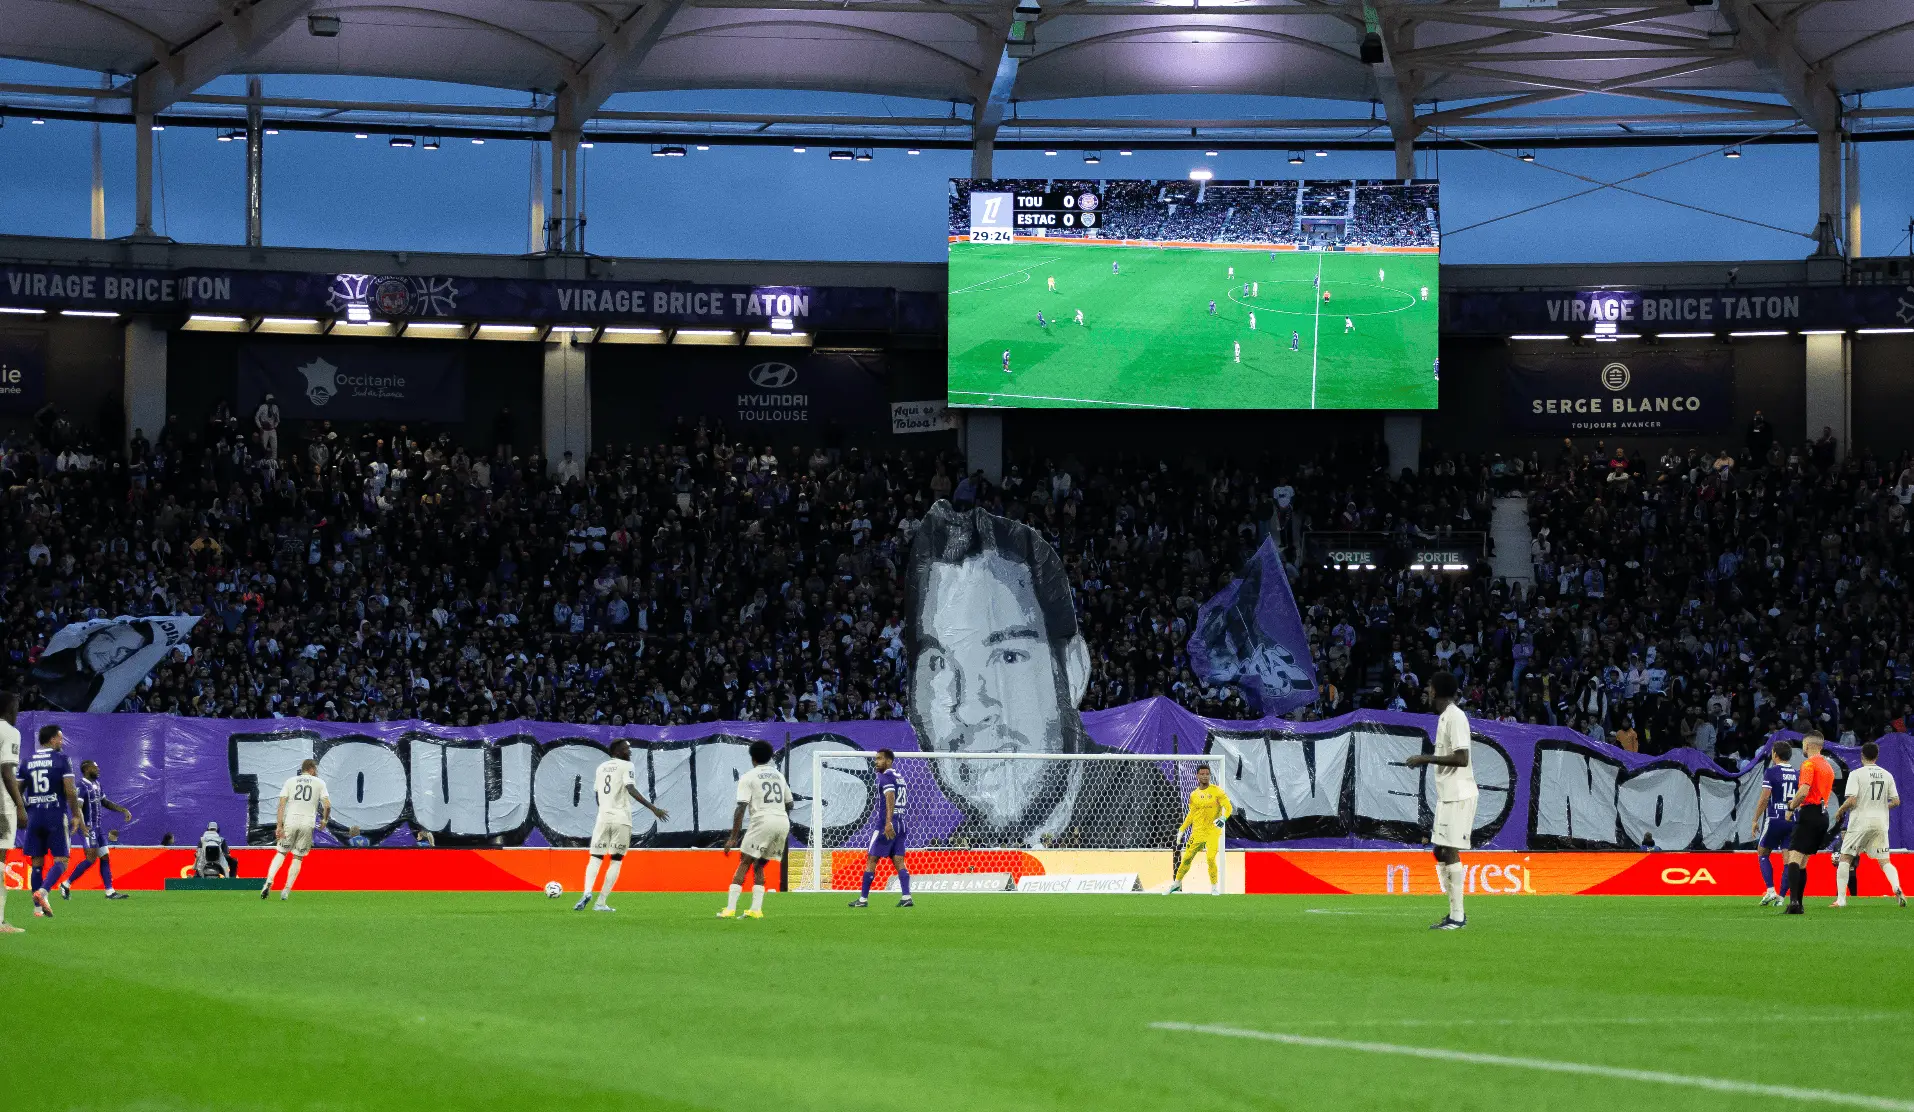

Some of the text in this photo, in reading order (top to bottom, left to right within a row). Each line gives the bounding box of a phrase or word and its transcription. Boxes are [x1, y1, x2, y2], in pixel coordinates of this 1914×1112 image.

[1017, 196, 1043, 207] TOU
[1063, 195, 1074, 208] 0
[1017, 213, 1074, 226] ESTAC 0
[972, 231, 1011, 241] 29:24
[8, 273, 96, 298] VIRAGE
[104, 276, 175, 301] BRICE
[557, 288, 809, 317] VIRAGE BRICE TATON
[1546, 295, 1799, 322] VIRAGE BRICE TATON
[336, 373, 406, 387] Occitanie
[737, 394, 808, 406] HYUNDAI
[1532, 396, 1701, 414] SERGE BLANCO
[737, 410, 808, 421] TOULOUSE
[1328, 552, 1371, 562] SORTIE
[1417, 552, 1459, 562] SORTIE
[30, 769, 50, 793] 15
[603, 774, 611, 794] 8
[293, 784, 313, 801] 20
[761, 781, 783, 804] 29
[1781, 782, 1796, 801] 14
[1869, 780, 1885, 800] 17
[910, 879, 1001, 890] SERGE BLANCO
[1661, 867, 1717, 885] CA
